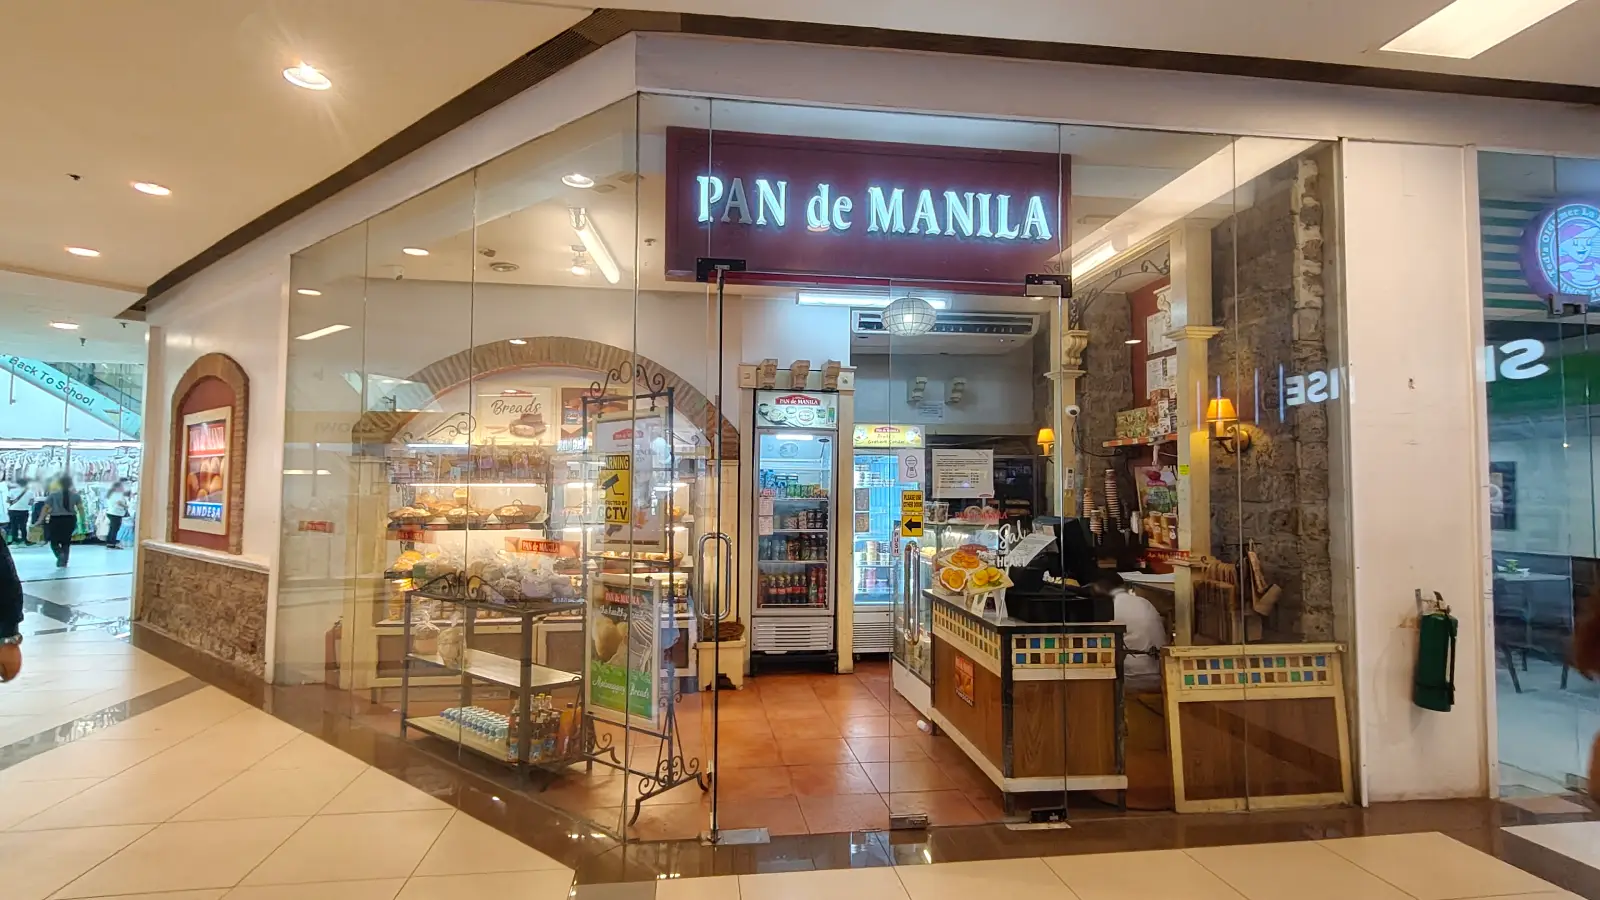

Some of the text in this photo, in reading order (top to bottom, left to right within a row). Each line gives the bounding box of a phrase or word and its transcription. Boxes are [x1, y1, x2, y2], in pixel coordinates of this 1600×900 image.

[696, 175, 1052, 241] PAN de MANILA
[9, 356, 95, 406] Back To School
[490, 397, 542, 415] Breads
[599, 455, 629, 470] ARNING
